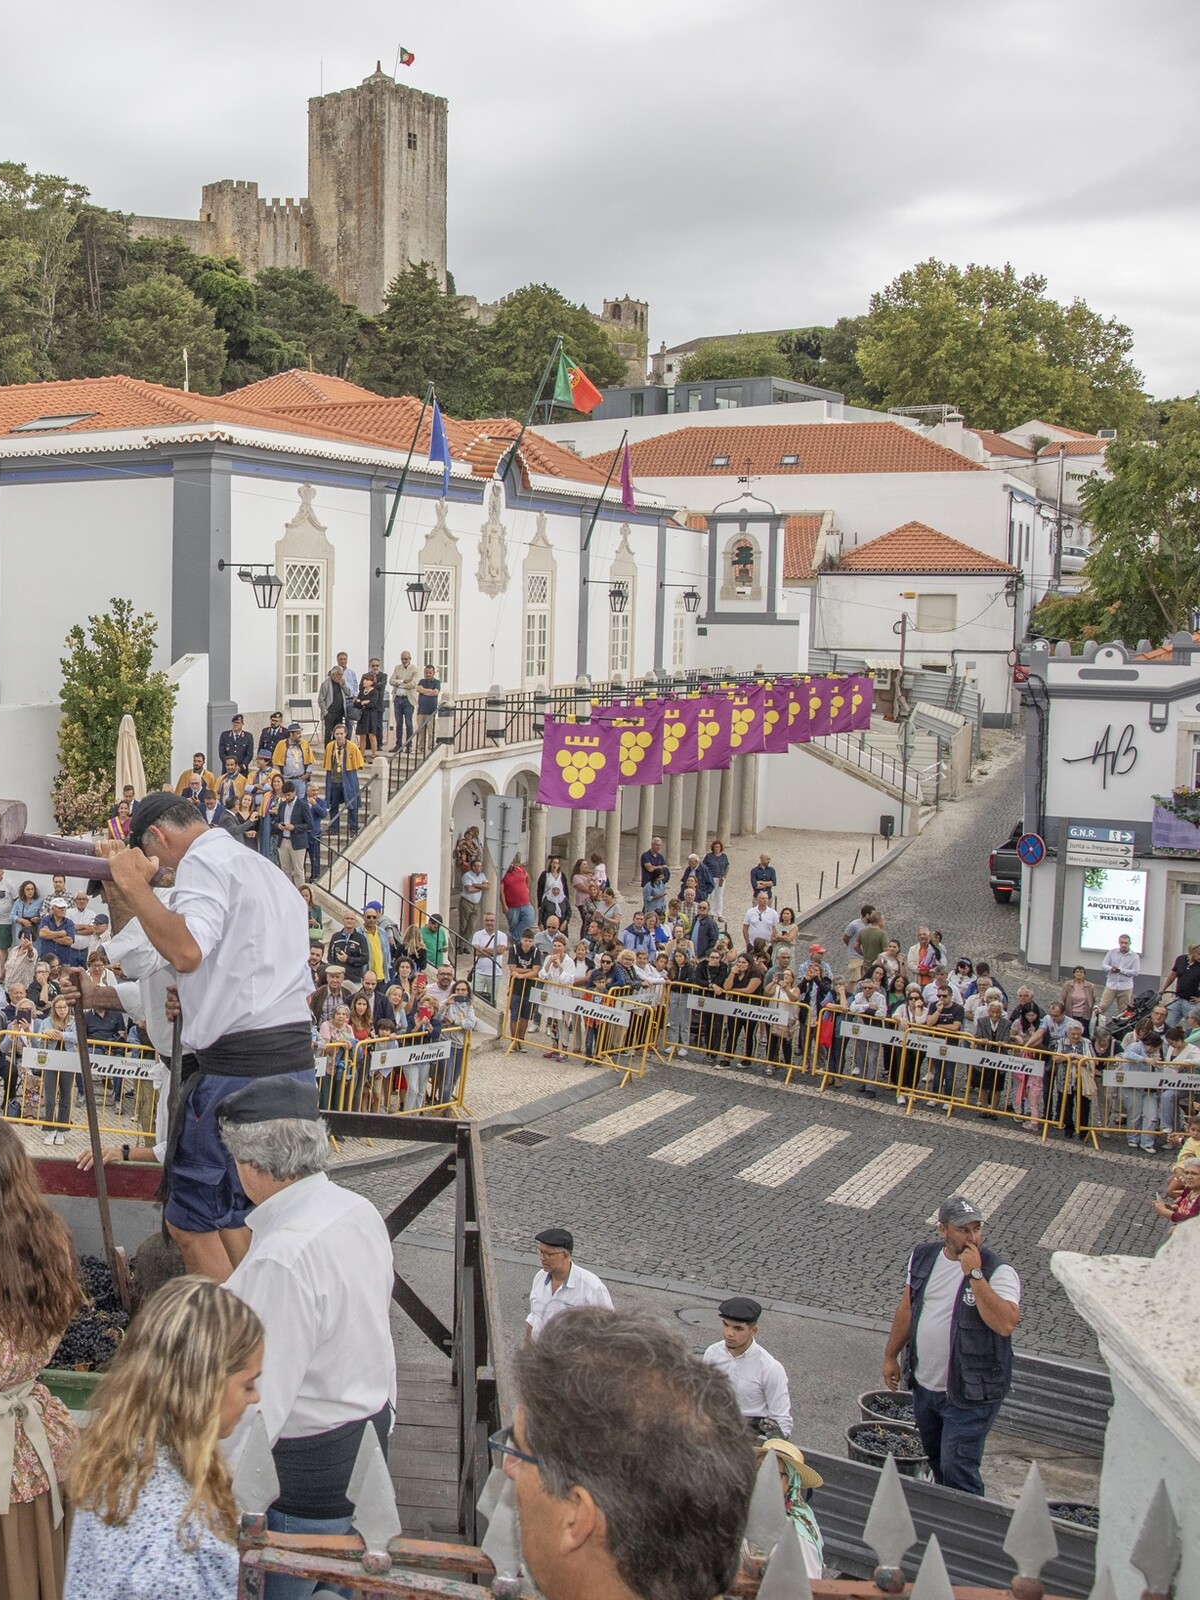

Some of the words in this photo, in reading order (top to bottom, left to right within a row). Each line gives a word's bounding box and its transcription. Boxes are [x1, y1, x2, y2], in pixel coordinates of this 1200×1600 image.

[1070, 828, 1097, 838] G.N.R.
[1088, 896, 1127, 905] PROJETOS
[1088, 902, 1140, 911] ARQUITETURA
[574, 1005, 620, 1023] Palmela
[733, 1008, 779, 1022] Palmela
[890, 1036, 928, 1049] Palme
[408, 1050, 444, 1062] Palmela
[979, 1058, 1033, 1073] Palmela
[1158, 1079, 1200, 1089] Palme
[960, 1201, 974, 1212] LA
